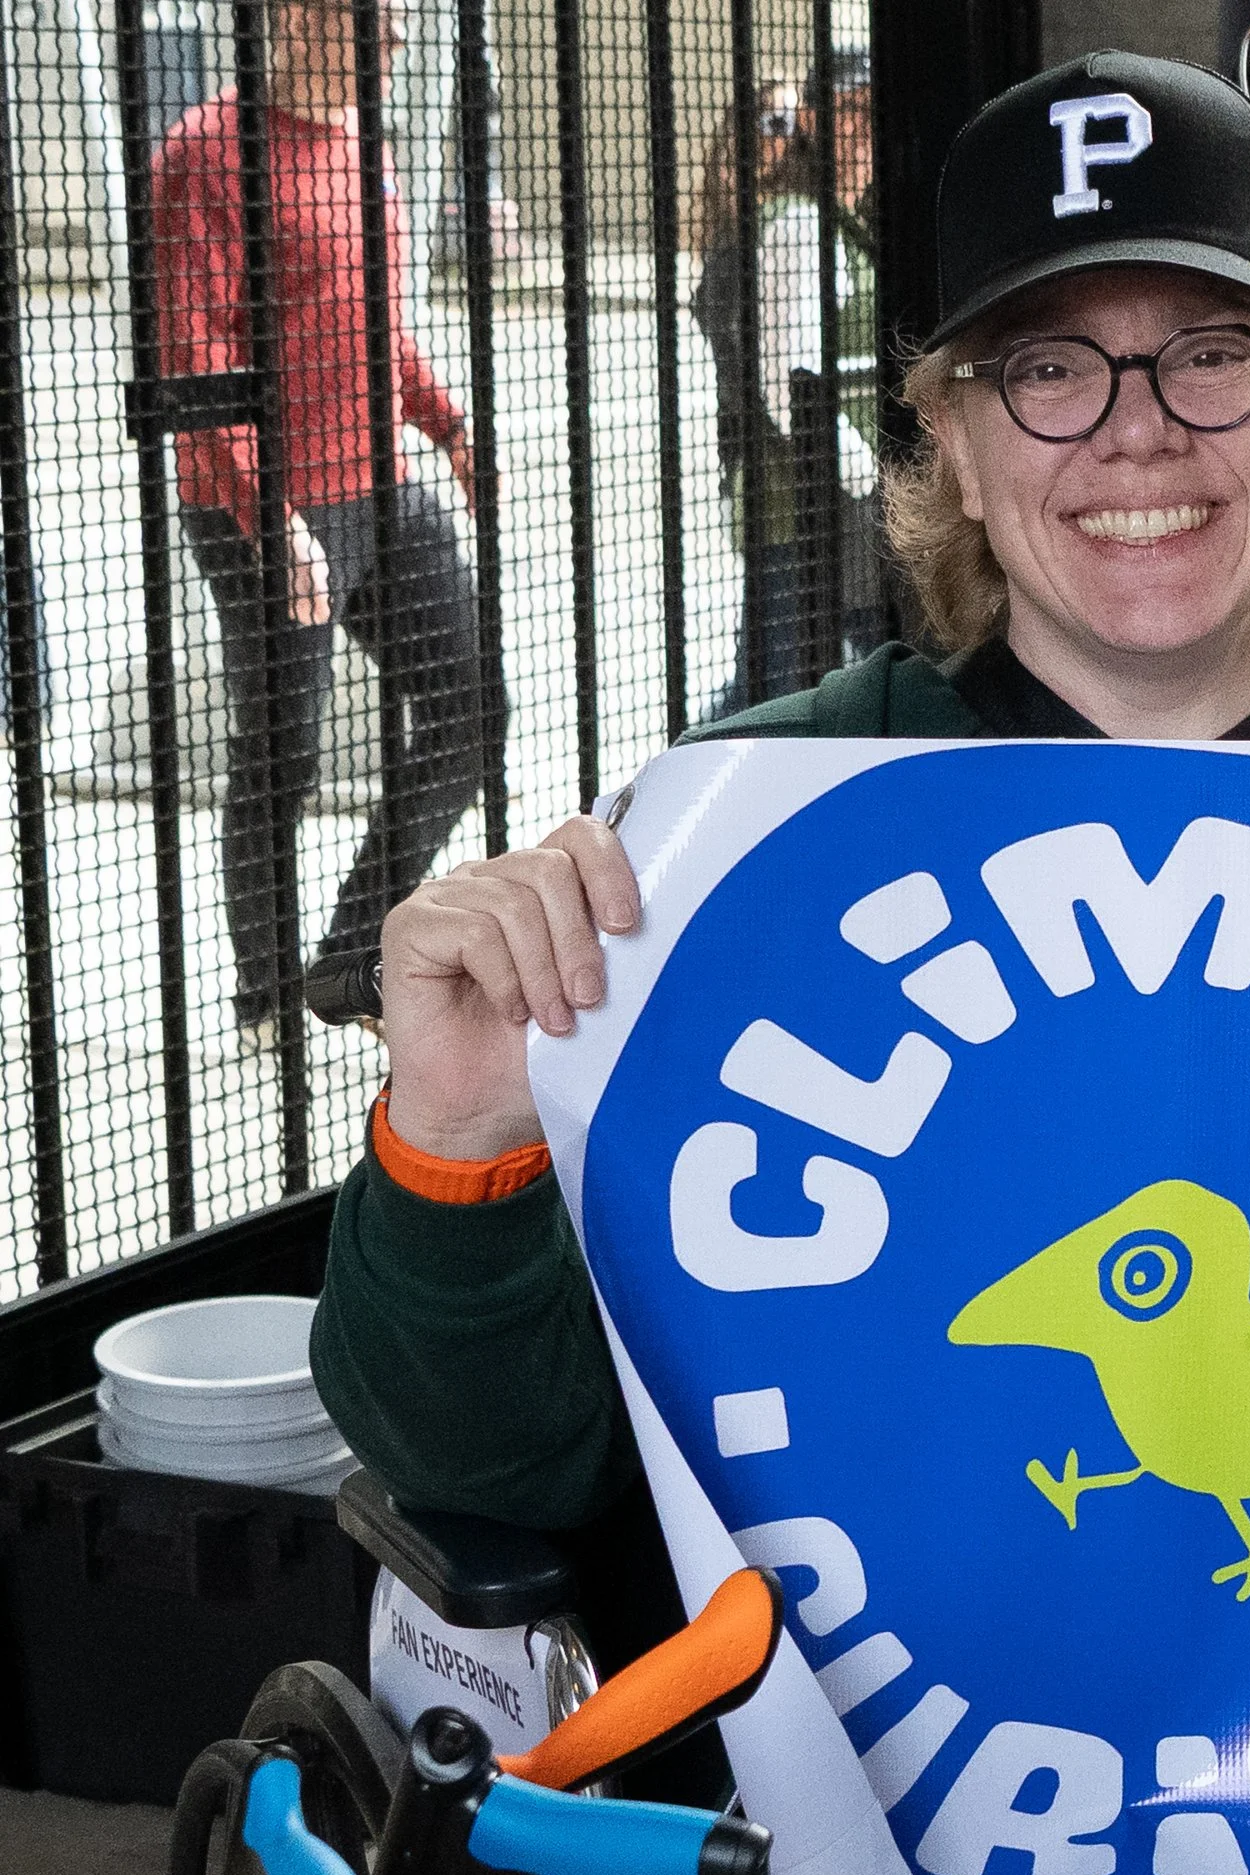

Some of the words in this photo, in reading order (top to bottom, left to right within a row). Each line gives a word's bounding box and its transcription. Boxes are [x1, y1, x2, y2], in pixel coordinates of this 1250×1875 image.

[1050, 93, 1153, 218] P
[392, 1609, 419, 1662] FAN
[421, 1632, 525, 1728] EXPERIENCE
